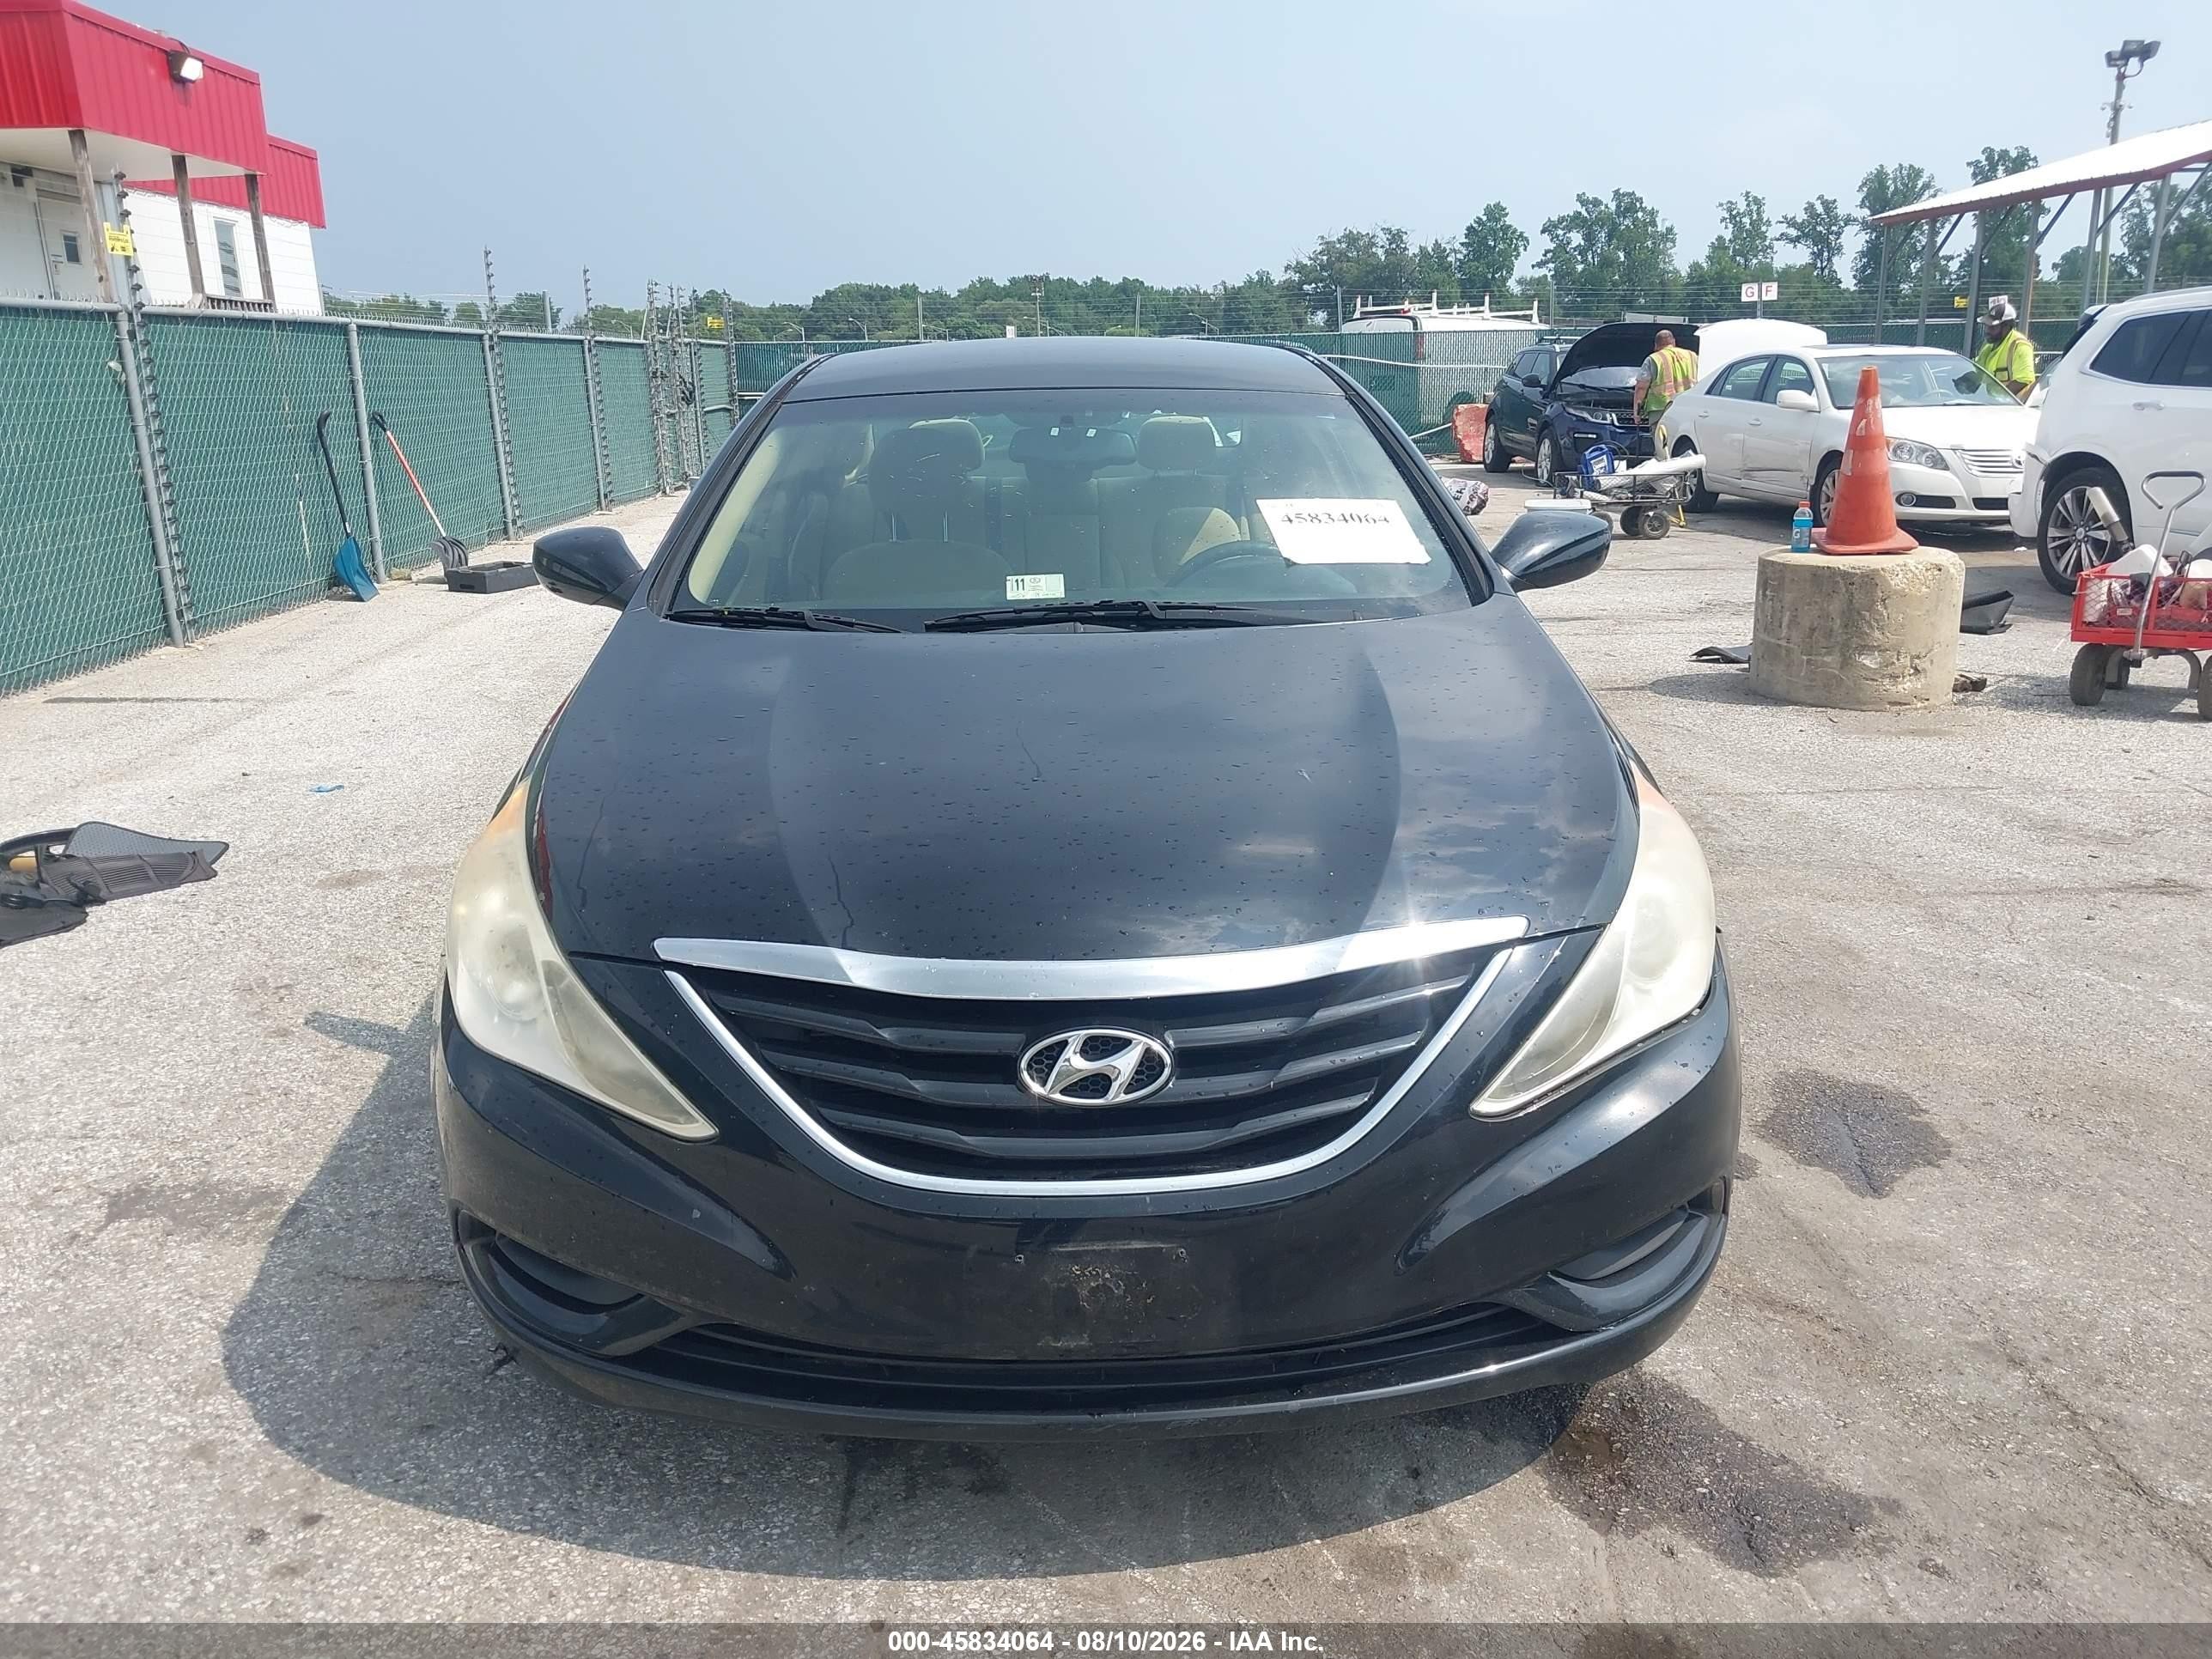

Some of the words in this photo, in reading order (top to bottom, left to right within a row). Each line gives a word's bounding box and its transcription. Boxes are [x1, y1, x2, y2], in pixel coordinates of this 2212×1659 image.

[1745, 286, 1754, 298] G
[1765, 285, 1773, 297] F
[1281, 513, 1390, 525] 45834064
